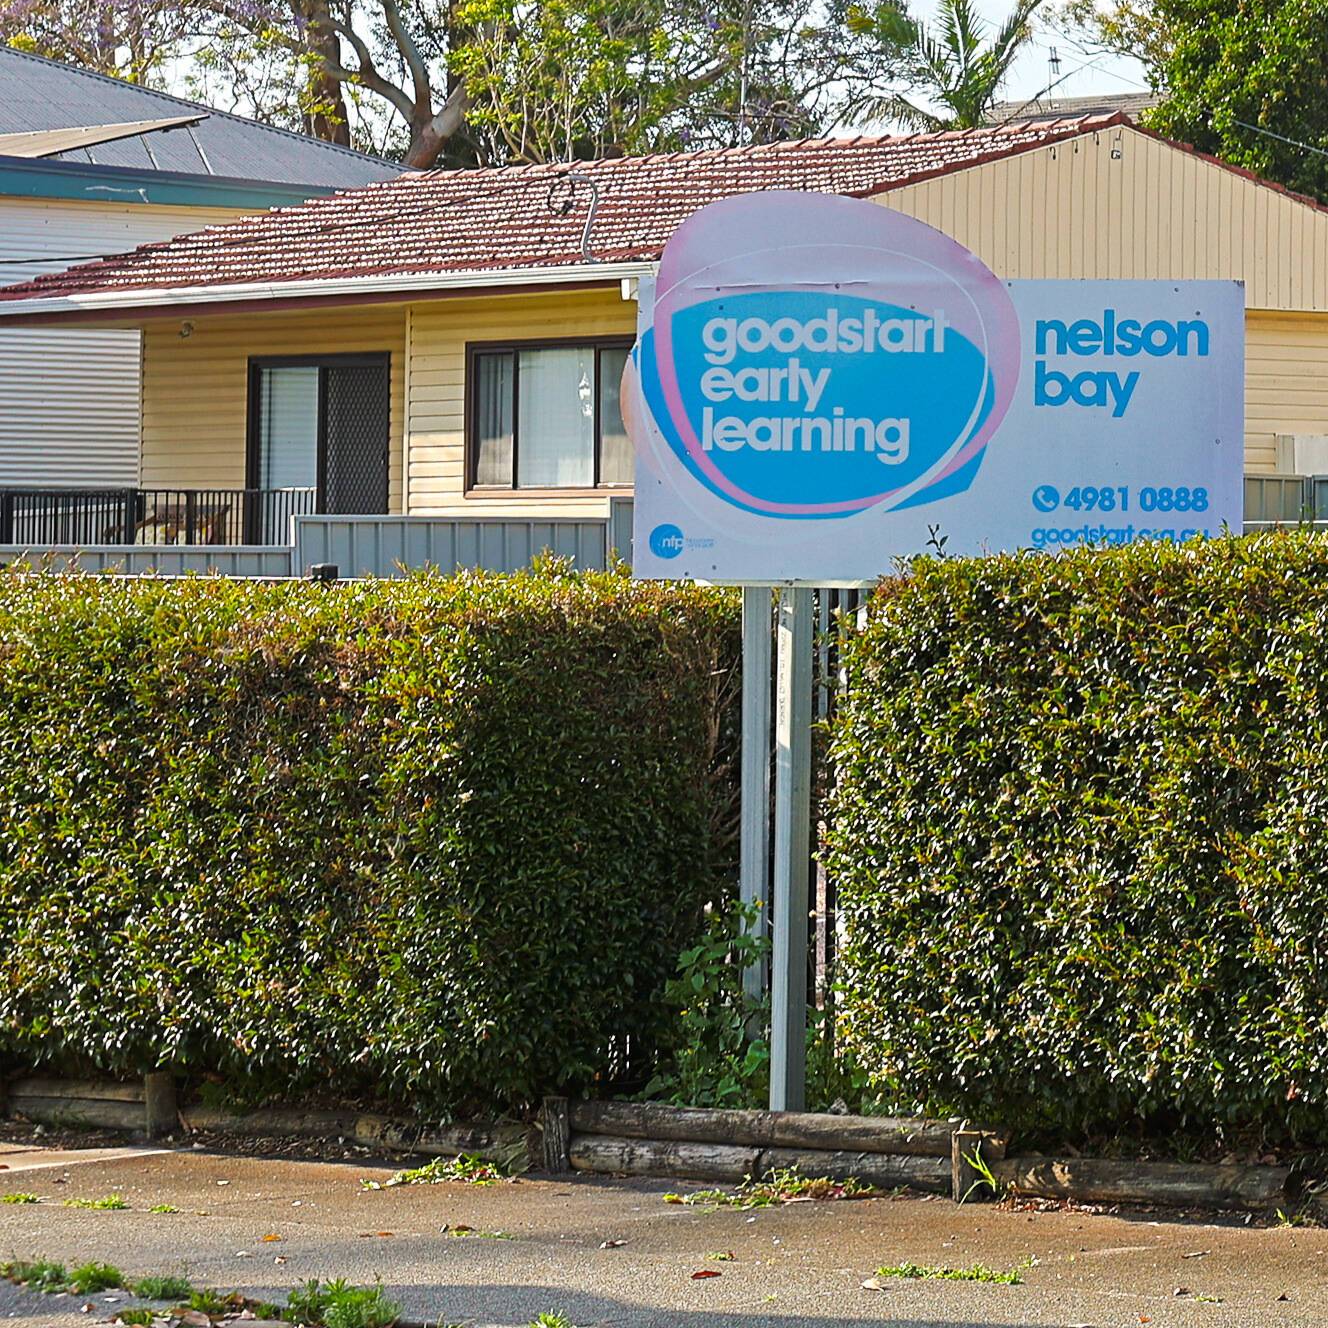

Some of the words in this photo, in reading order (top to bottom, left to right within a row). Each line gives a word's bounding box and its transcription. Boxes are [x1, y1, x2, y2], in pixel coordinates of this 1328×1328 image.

[702, 308, 950, 365] goodstart
[1035, 309, 1209, 356] nelson
[700, 358, 832, 412] early
[1034, 360, 1140, 418] bay
[702, 406, 910, 465] learning
[1063, 486, 1129, 512] 4981
[1139, 486, 1208, 513] 0888
[1031, 524, 1209, 548] goodstartorga
